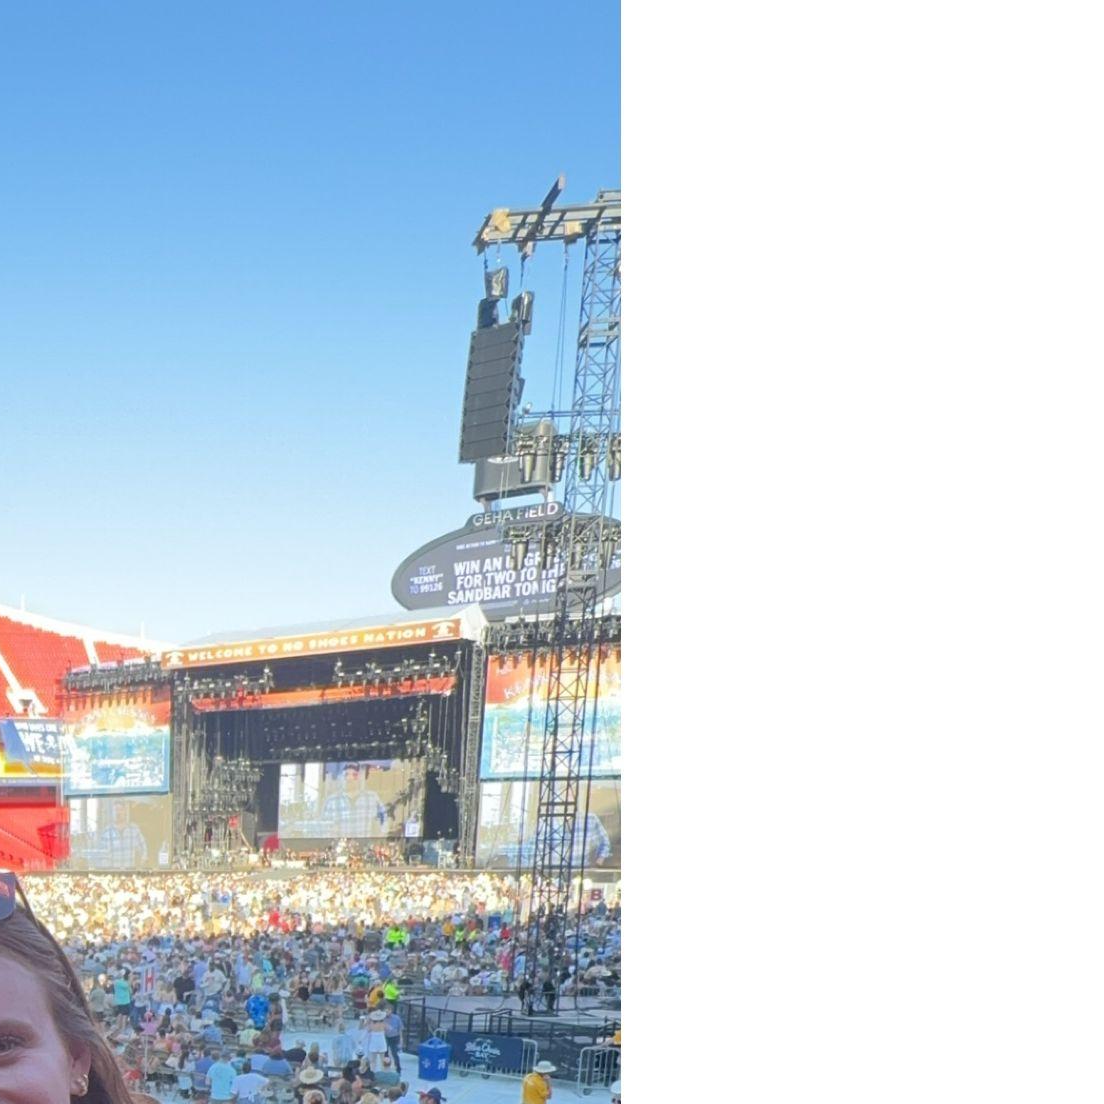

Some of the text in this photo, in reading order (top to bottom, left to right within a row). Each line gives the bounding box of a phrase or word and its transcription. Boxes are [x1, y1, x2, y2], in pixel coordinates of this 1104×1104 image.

[473, 502, 559, 527] GEHA FIELD
[453, 559, 481, 576] WIN
[483, 556, 503, 573] AN
[456, 573, 483, 590] FOR
[485, 568, 516, 586] TWO
[520, 566, 537, 582] TO
[447, 584, 511, 605] SANDBAR
[188, 627, 427, 661] WELCOME TO NO SHOES NATION
